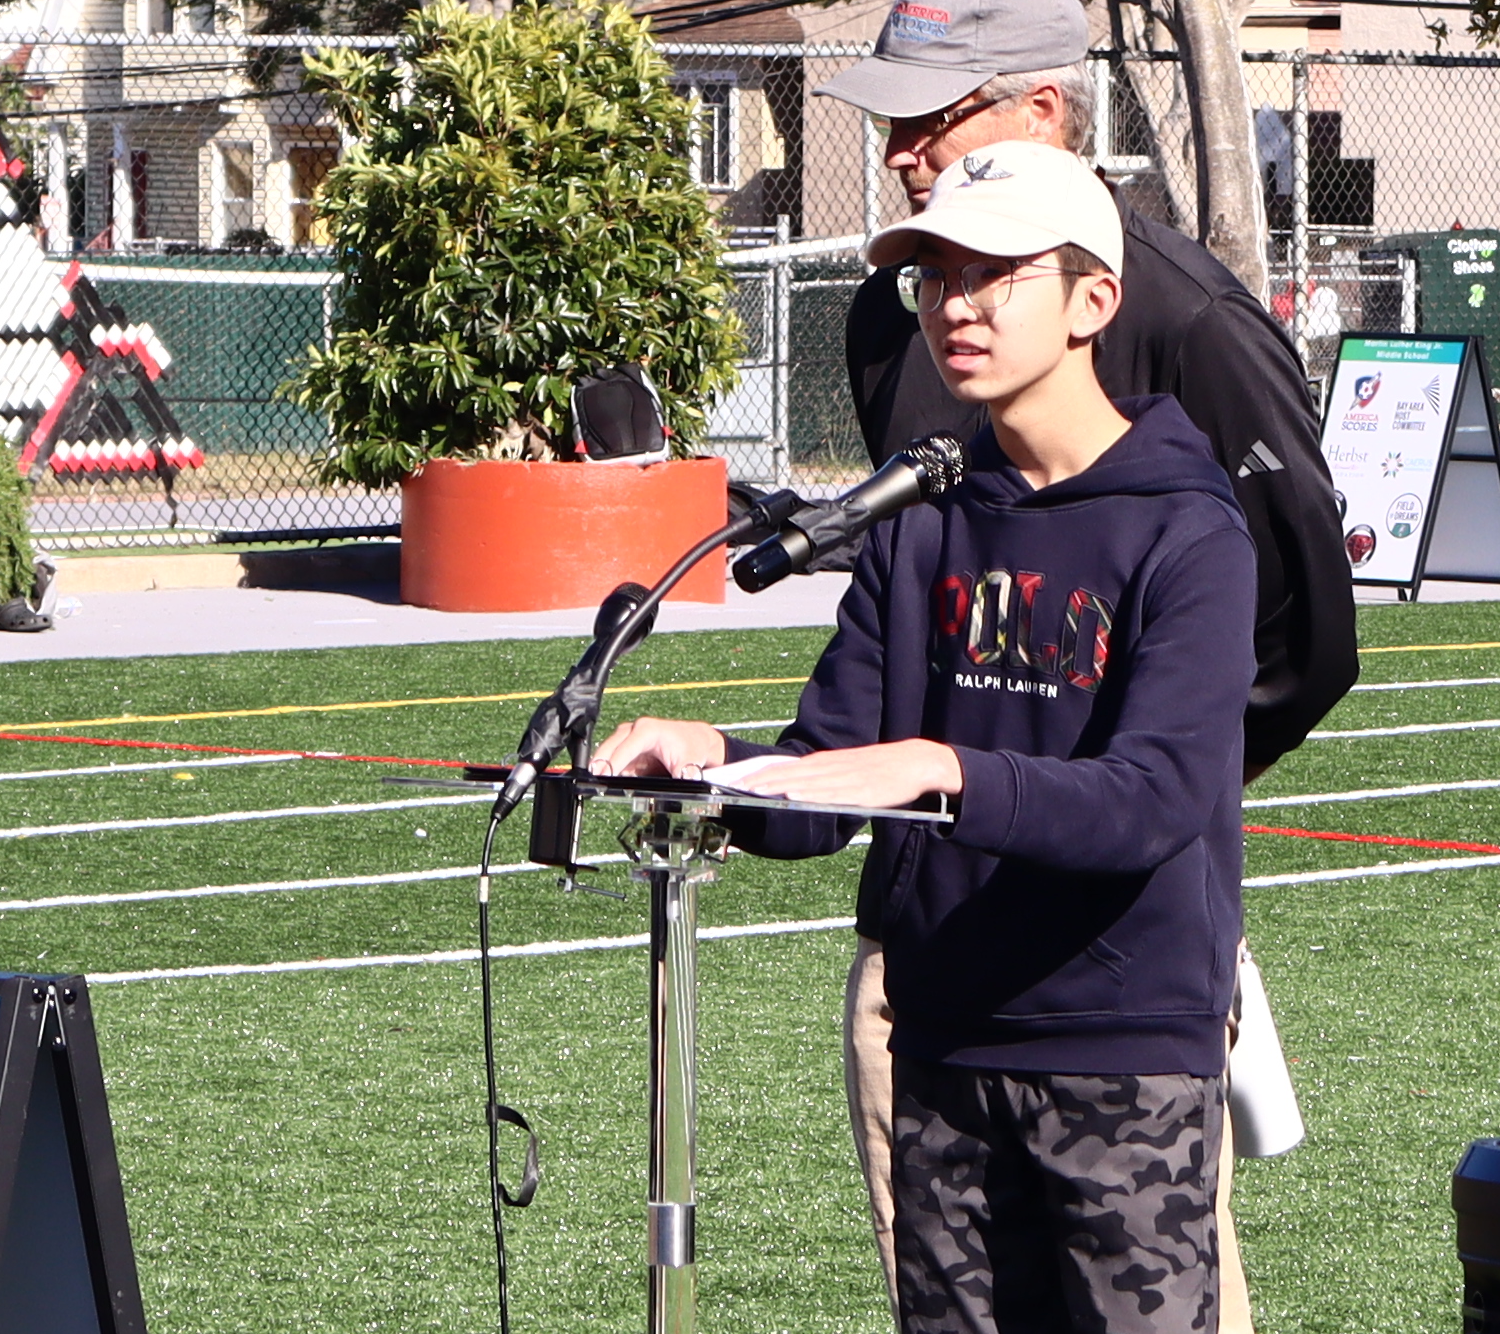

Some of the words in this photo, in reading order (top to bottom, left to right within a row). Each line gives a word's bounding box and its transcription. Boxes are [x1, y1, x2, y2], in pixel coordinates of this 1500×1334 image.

[1327, 444, 1369, 464] Herbst
[929, 568, 1116, 695] POLO
[955, 673, 1001, 690] RALPH
[1007, 677, 1058, 699] LAUREN
